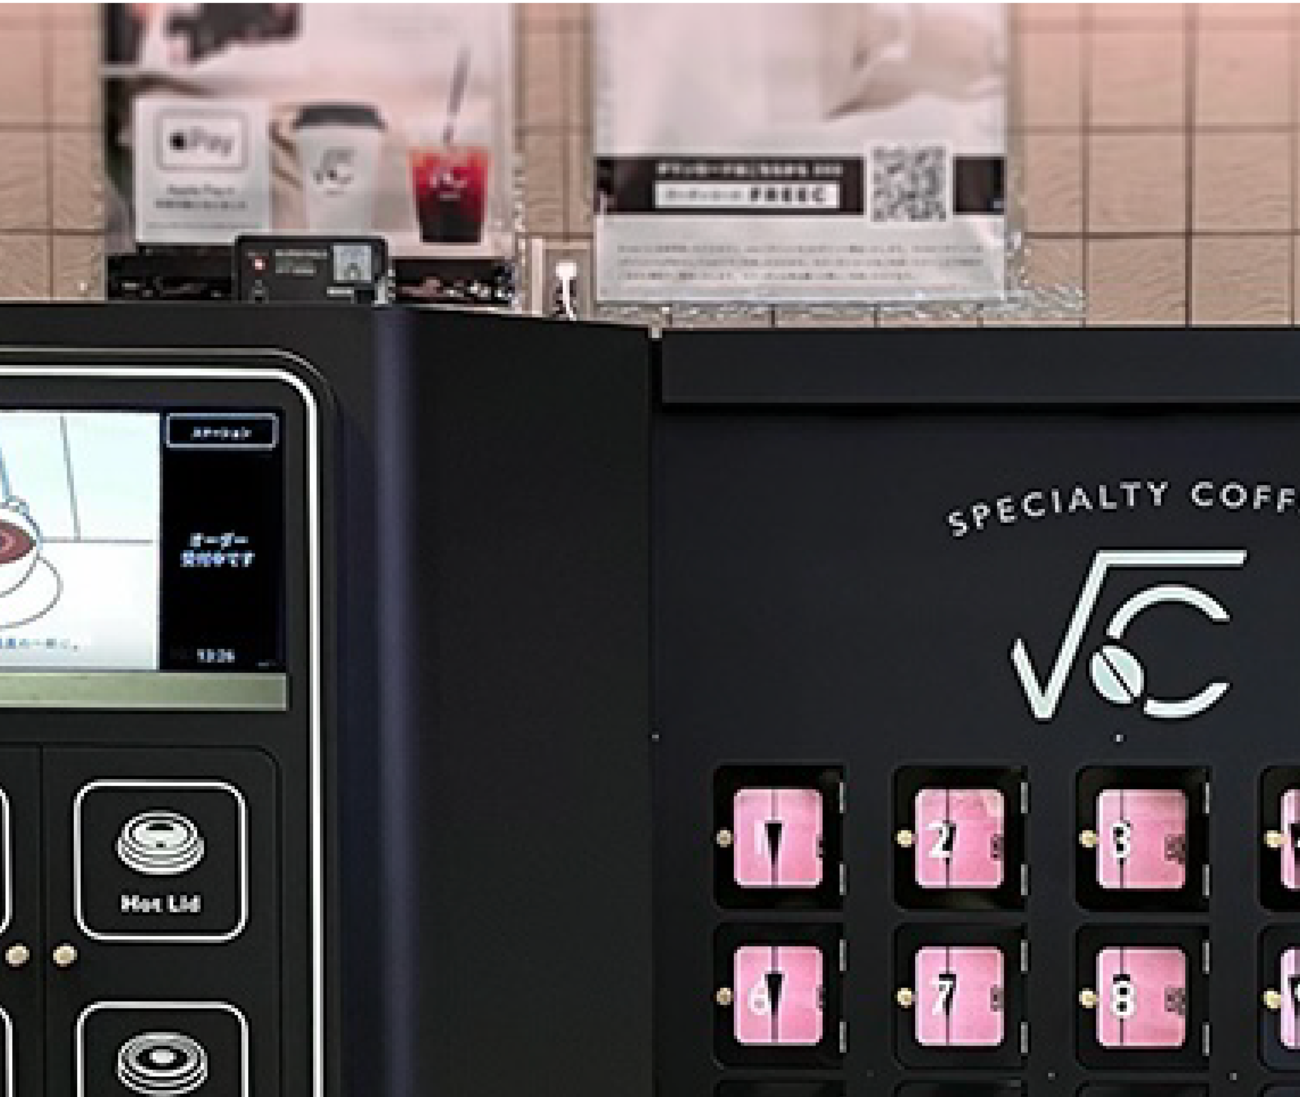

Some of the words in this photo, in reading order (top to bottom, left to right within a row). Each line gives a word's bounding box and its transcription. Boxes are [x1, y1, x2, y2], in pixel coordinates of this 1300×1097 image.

[948, 481, 1169, 537] SPECIALTY
[926, 823, 952, 858] 2
[1110, 822, 1132, 858] 3
[120, 894, 162, 913] Hot
[168, 894, 201, 913] Lid
[748, 972, 770, 1016] 6
[931, 976, 954, 1017] 7
[1111, 980, 1136, 1018] 8
